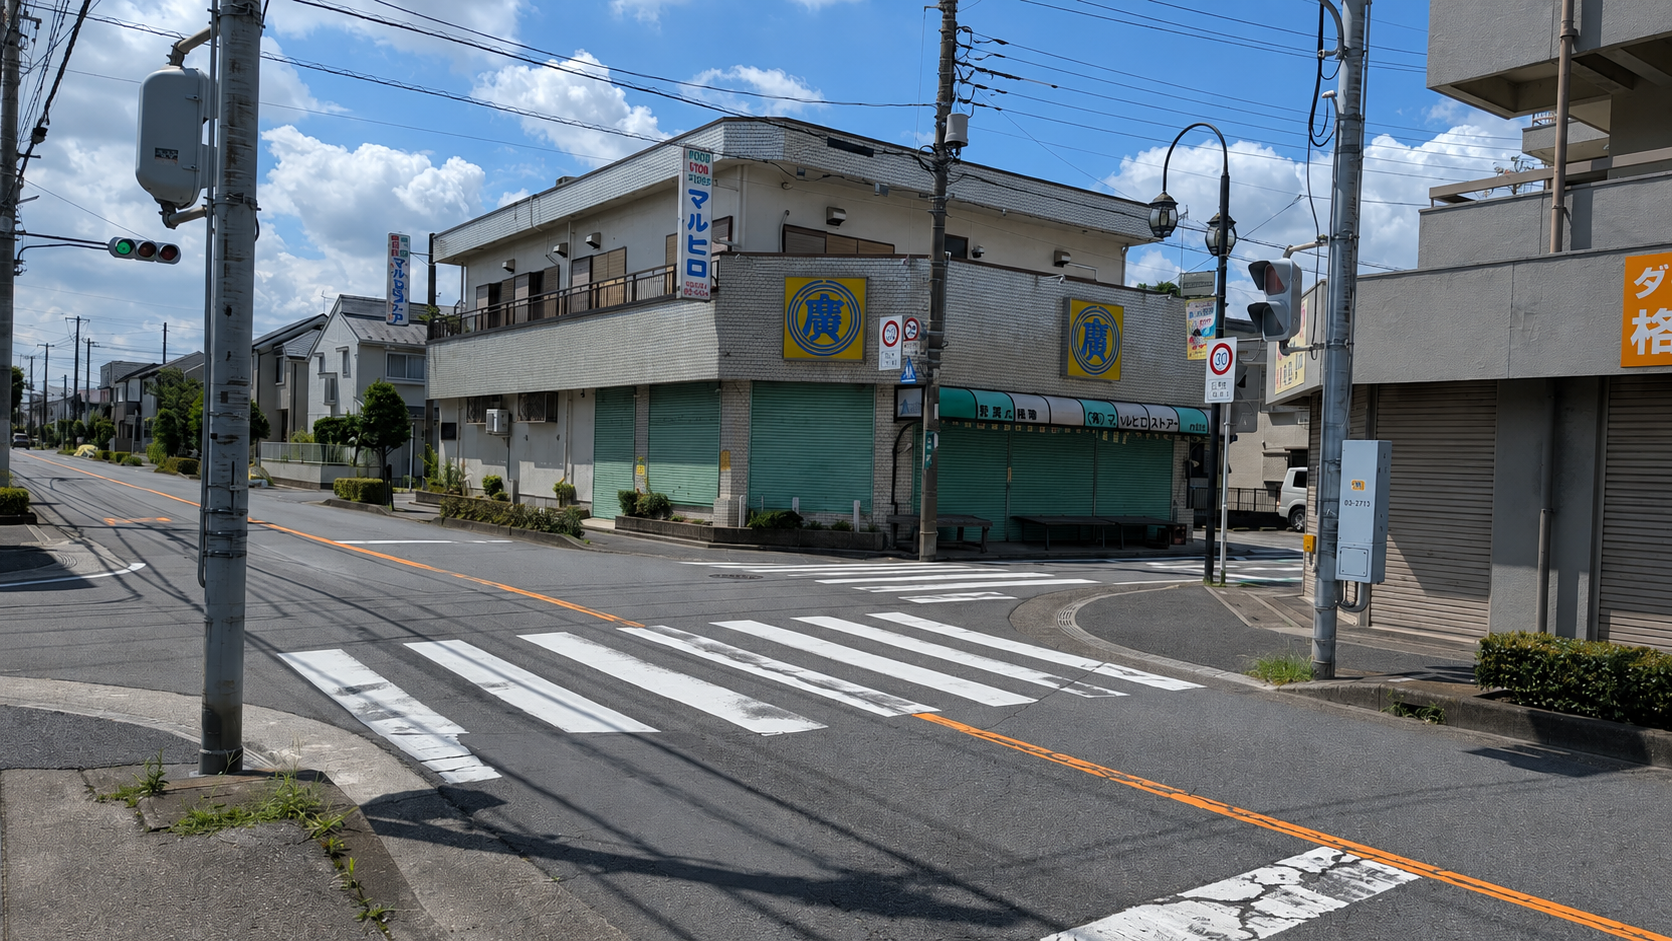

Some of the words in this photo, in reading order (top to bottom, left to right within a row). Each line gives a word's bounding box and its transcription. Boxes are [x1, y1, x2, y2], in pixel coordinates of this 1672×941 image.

[687, 188, 709, 279] マルヒロ
[1633, 263, 1672, 300] ダ
[1214, 352, 1228, 366] 30
